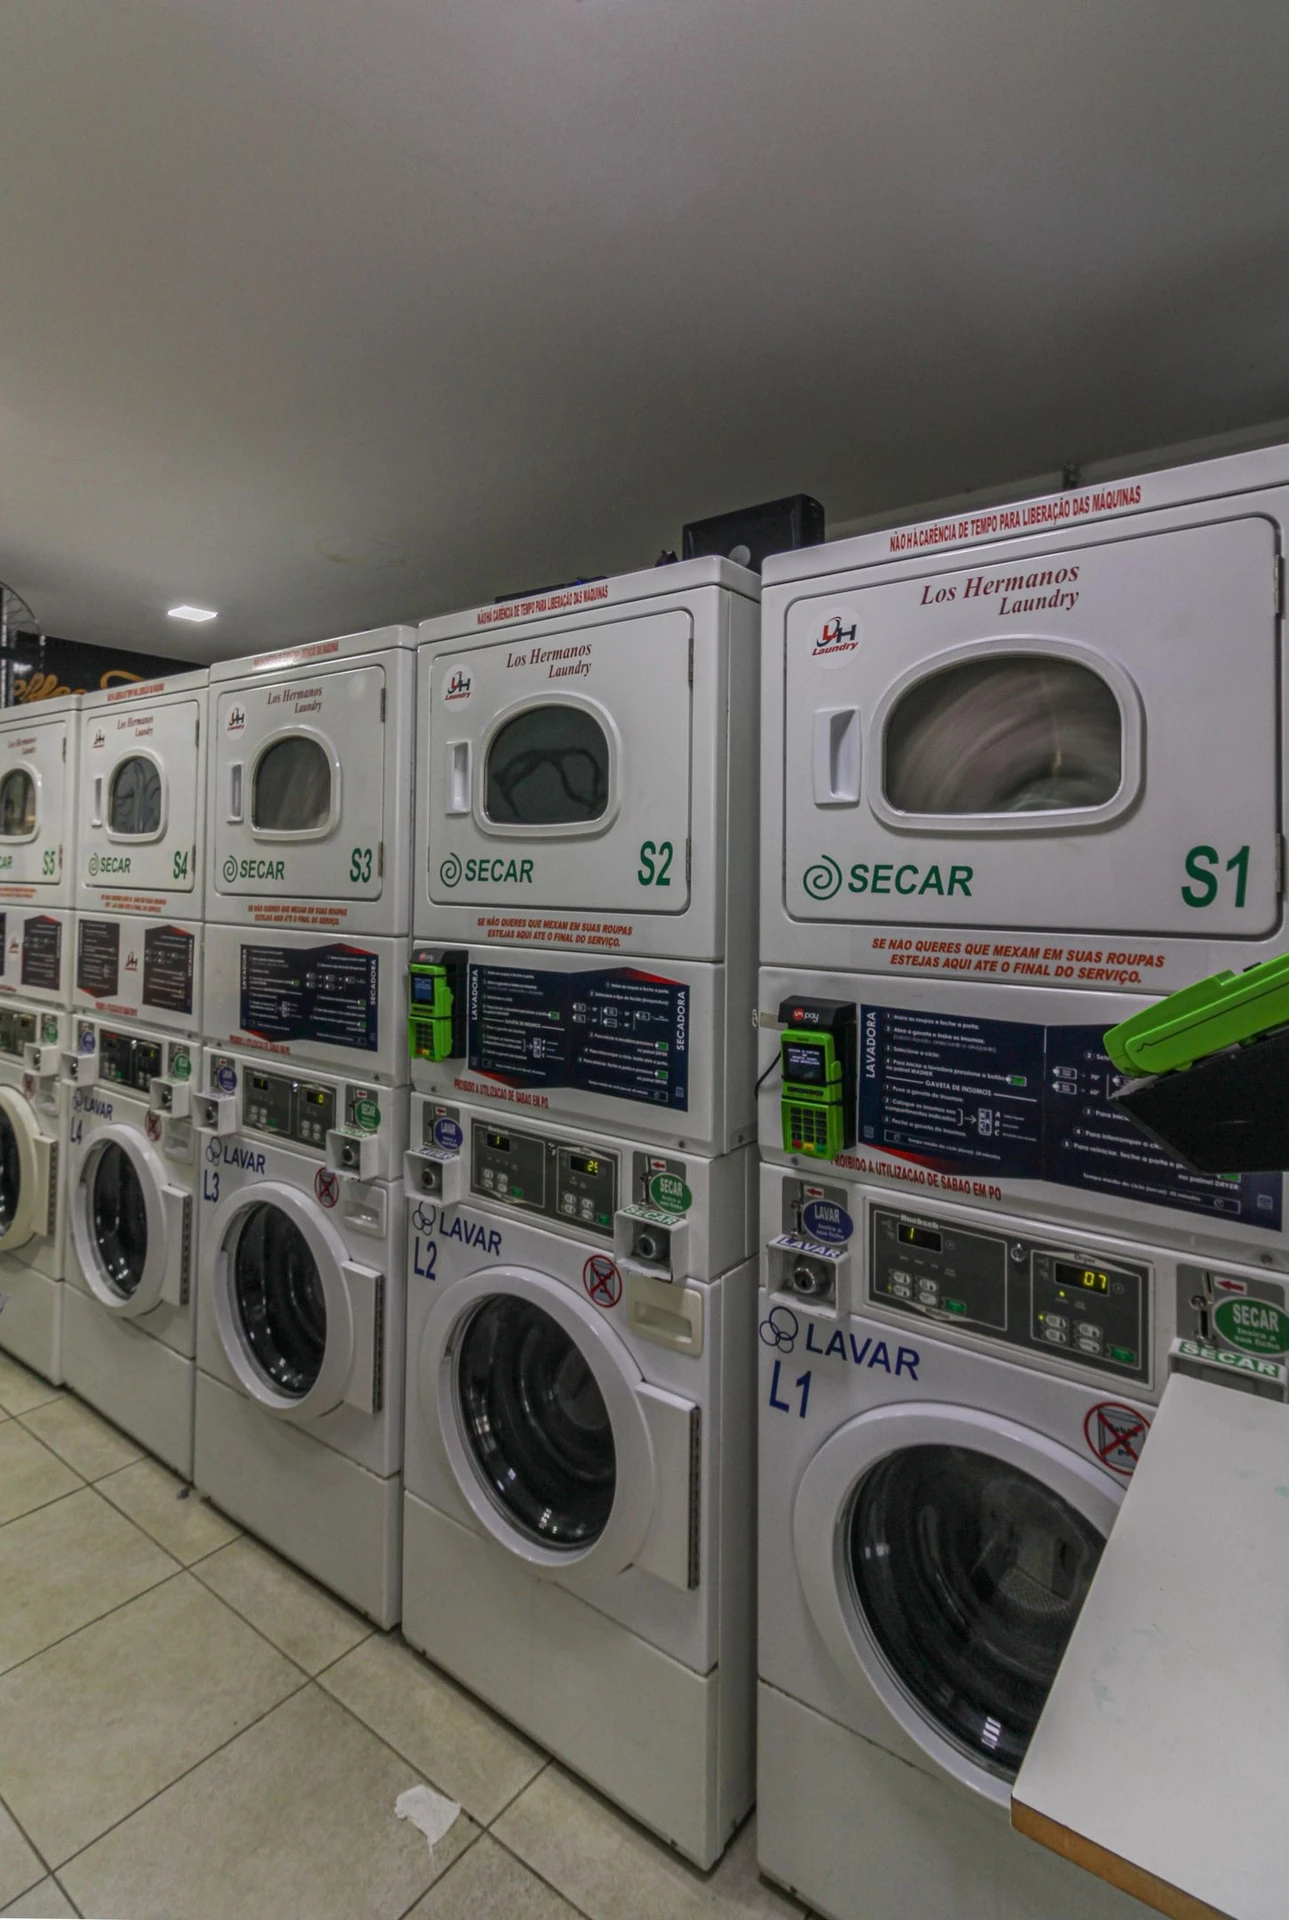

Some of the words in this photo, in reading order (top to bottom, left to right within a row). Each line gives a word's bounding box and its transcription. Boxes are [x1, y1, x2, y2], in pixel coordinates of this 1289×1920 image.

[919, 523, 957, 546] CARÊNCIA
[958, 521, 969, 539] DE
[971, 515, 997, 537] TEMPO
[1000, 511, 1021, 531] PARA
[1023, 498, 1070, 526] LIBERAÇÃO
[1073, 495, 1090, 516] DAS
[1092, 485, 1141, 512] MÁQUINAS
[920, 585, 957, 606] Los
[963, 565, 1080, 599] Hermanos
[514, 603, 520, 617] DE
[520, 601, 536, 616] TEMPO
[535, 599, 547, 613] PARA
[573, 590, 583, 605] DAS
[998, 588, 1080, 616] Laundry
[506, 652, 527, 669] Los
[529, 643, 593, 665] Hermanos
[811, 640, 859, 657] Laundry
[548, 660, 592, 679] Laundry
[267, 692, 281, 705] Los
[282, 687, 323, 702] Hermanos
[294, 699, 322, 714] Laundry
[42, 850, 56, 876] S5
[100, 857, 131, 874] SECAR
[173, 850, 188, 880] S4
[239, 859, 285, 881] SECAR
[349, 847, 373, 883] S3
[465, 858, 534, 884] SECAR
[637, 840, 674, 887] S2
[1181, 844, 1251, 909] S1
[848, 864, 974, 897] SECAR
[477, 917, 485, 926] SE
[501, 918, 527, 928] QUERES
[528, 919, 542, 929] QUE
[543, 919, 569, 931] MEXAM
[570, 921, 581, 931] EM
[582, 922, 601, 933] SUAS
[602, 924, 633, 937] ROUPAS
[487, 929, 515, 939] ESTEJAS
[516, 930, 532, 940] AQUI
[547, 932, 552, 941] O
[554, 932, 574, 943] FINAL
[575, 935, 586, 944] DO
[872, 938, 887, 949] SE
[915, 940, 962, 954] QUERES
[965, 943, 990, 956] QUE
[992, 945, 1040, 959] MEXAM
[1043, 948, 1063, 961] EM
[1066, 950, 1102, 964] SUAS
[1106, 952, 1165, 968] ROUPAS
[890, 954, 941, 968] ESTEJAS
[942, 957, 972, 971] AQUI
[1001, 961, 1011, 973] O
[1013, 962, 1051, 976] FINAL
[1054, 965, 1075, 978] DO
[1077, 967, 1142, 985] SERVIÇO.
[676, 991, 686, 1051] SECADORA
[866, 1012, 877, 1079] LAVADORA
[925, 1080, 951, 1090] GAVETA
[952, 1084, 961, 1092] DE
[84, 1095, 114, 1121] LAVAR
[223, 1143, 266, 1176] LAVAR
[204, 1168, 220, 1203] L3
[660, 1177, 683, 1198] SECAR
[868, 1160, 875, 1174] A
[927, 1173, 939, 1188] DE
[973, 1182, 987, 1198] EM
[814, 1204, 840, 1224] LAVAR
[439, 1211, 503, 1256] LAVAR
[779, 1236, 841, 1259] LAVAR
[414, 1236, 438, 1281] L2
[1084, 1271, 1107, 1290] 07
[1232, 1303, 1280, 1333] SECAR
[805, 1323, 920, 1382] LAVAR
[1182, 1342, 1276, 1377] SECAR
[769, 1359, 812, 1419] L1
